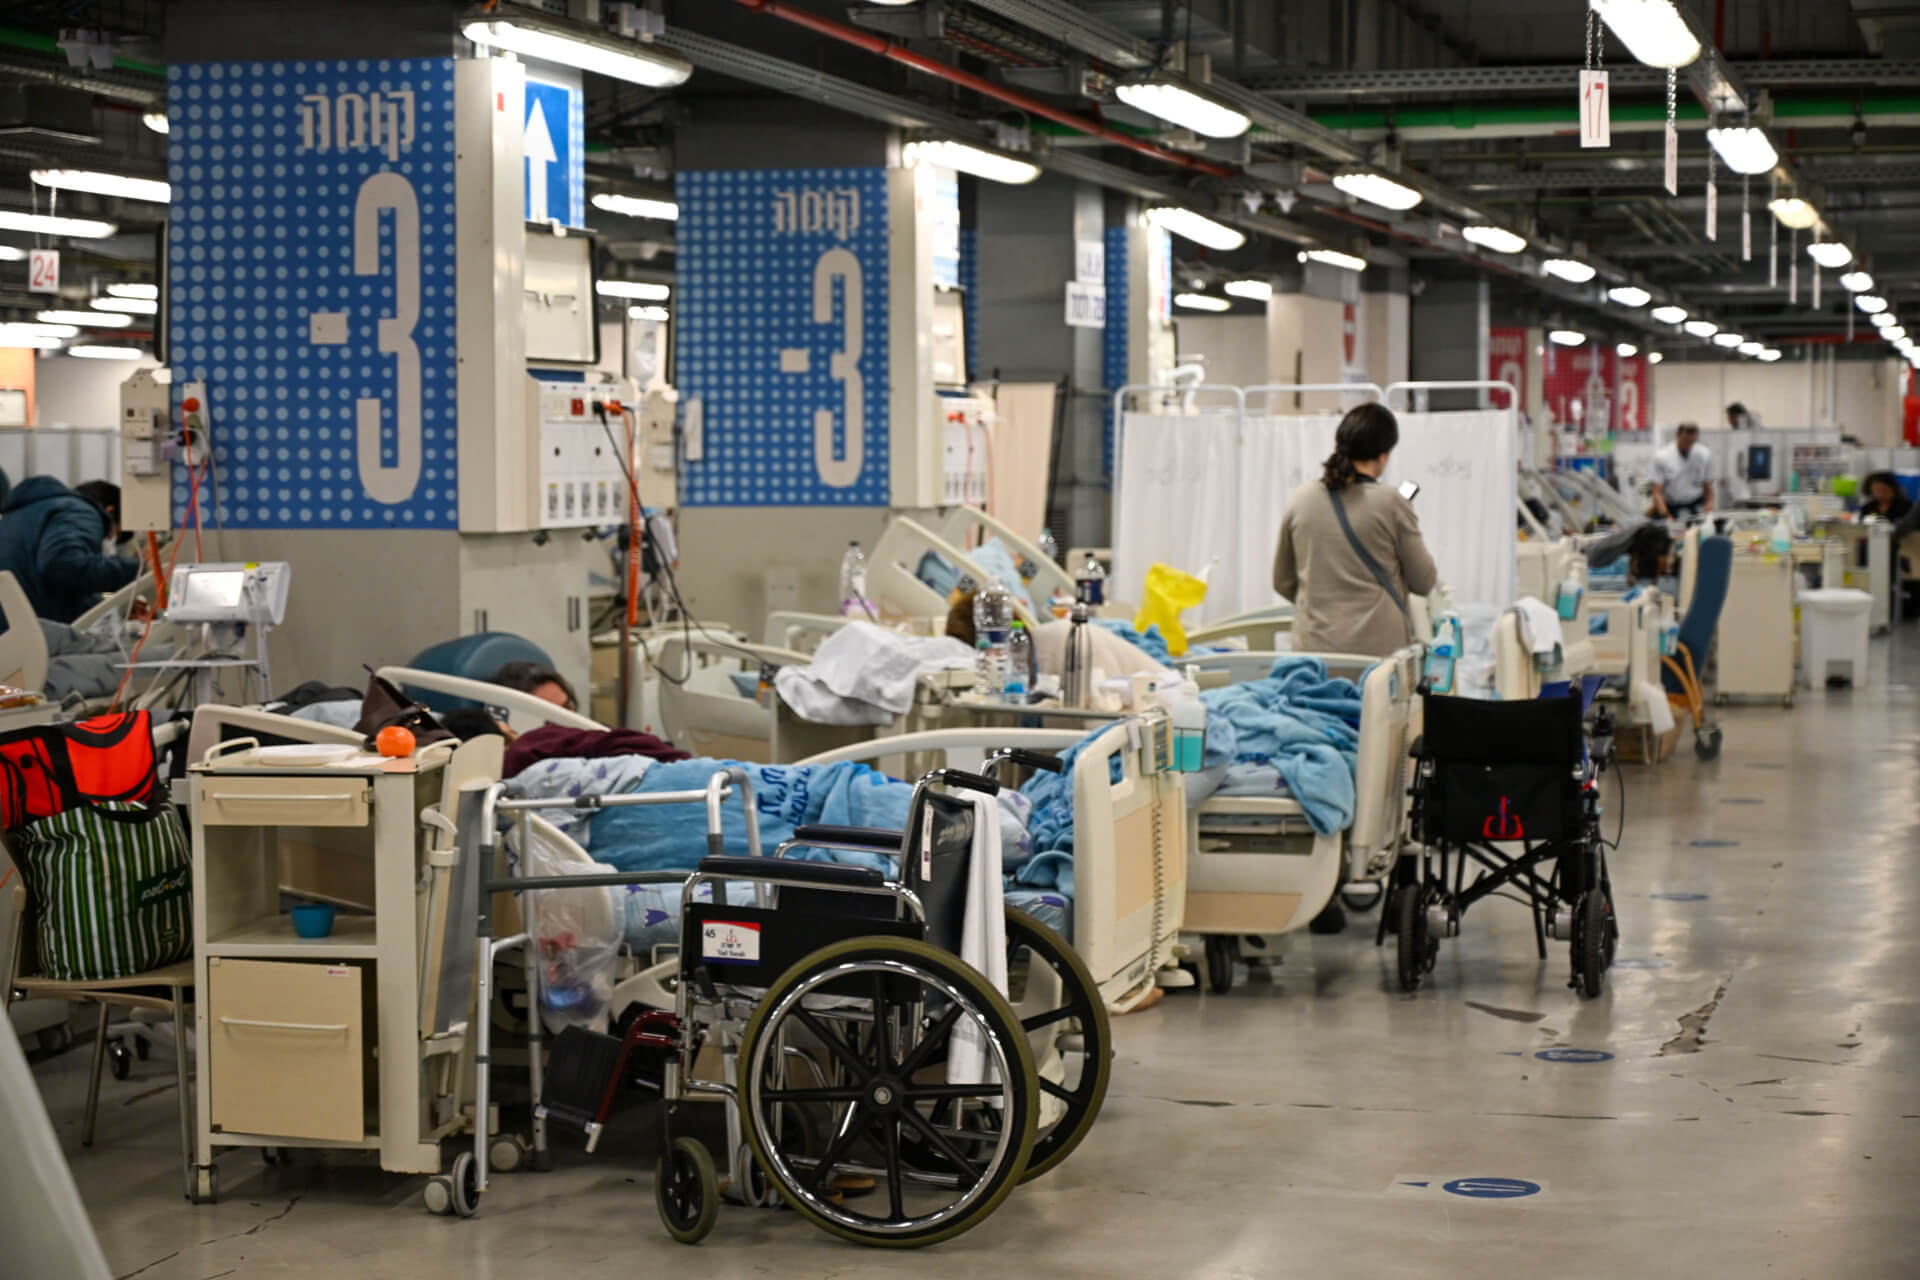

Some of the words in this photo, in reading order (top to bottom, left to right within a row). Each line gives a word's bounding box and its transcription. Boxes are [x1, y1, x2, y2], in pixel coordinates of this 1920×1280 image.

[303, 91, 415, 162] קומה
[1585, 81, 1604, 139] 17
[775, 189, 861, 241] קומה
[33, 256, 56, 287] 24
[704, 928, 717, 938] 45
